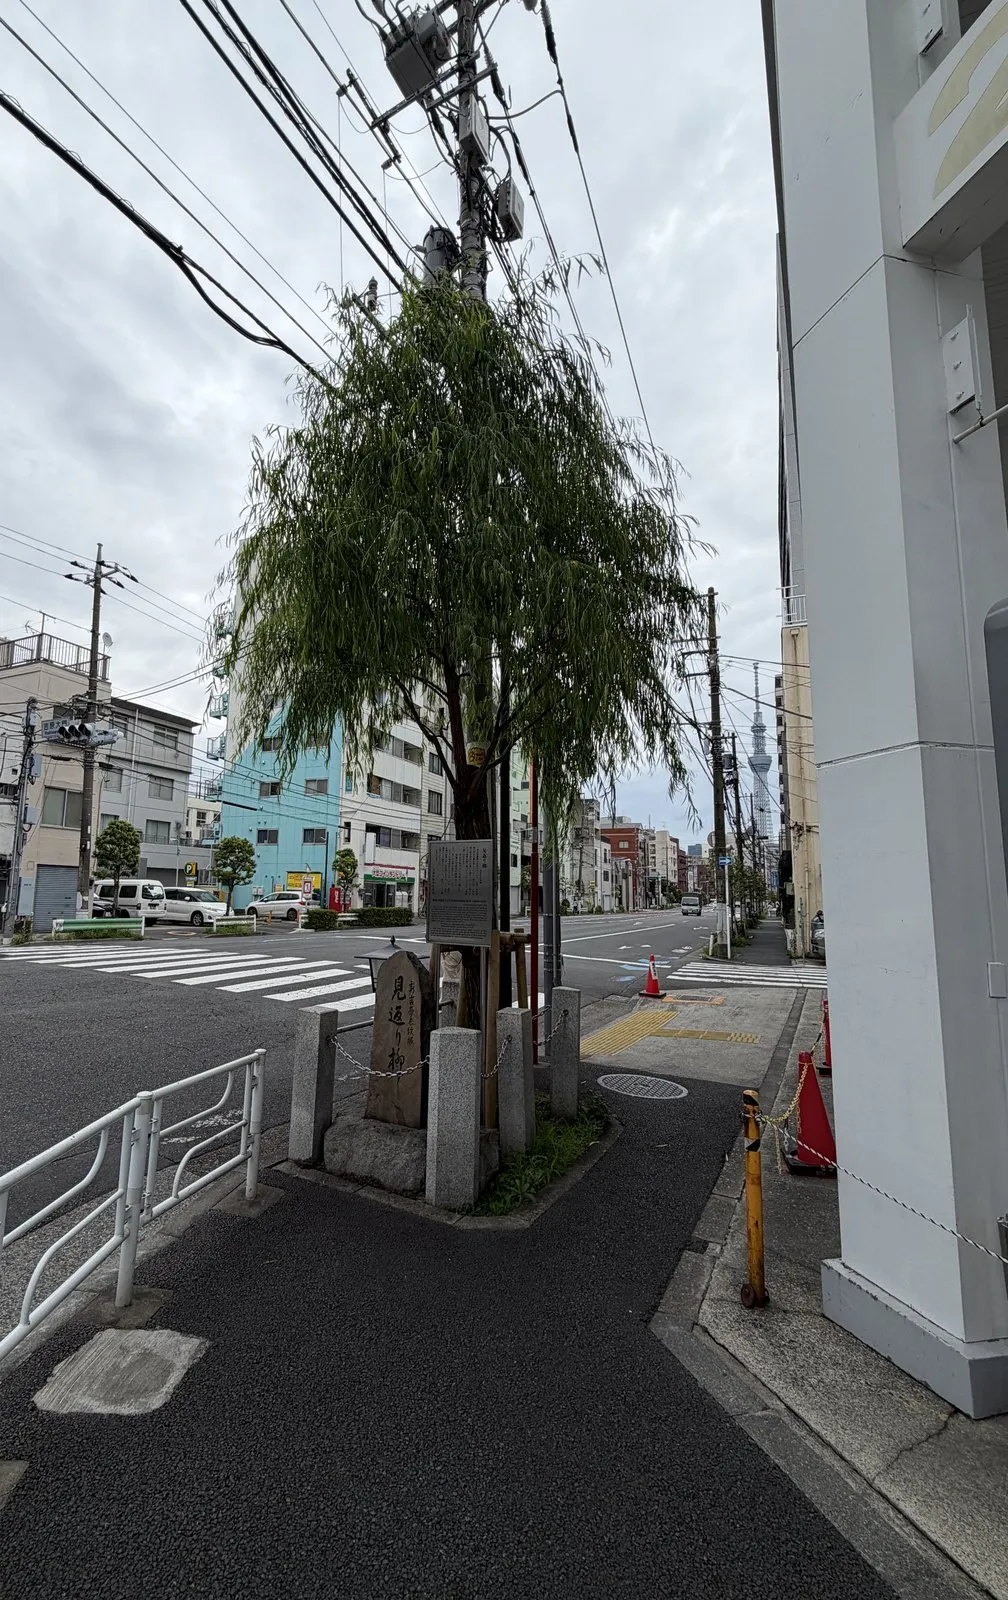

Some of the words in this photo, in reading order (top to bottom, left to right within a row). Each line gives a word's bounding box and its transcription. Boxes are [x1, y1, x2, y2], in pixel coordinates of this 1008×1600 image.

[186, 864, 192, 874] P
[388, 975, 406, 1094] 見返り柳
